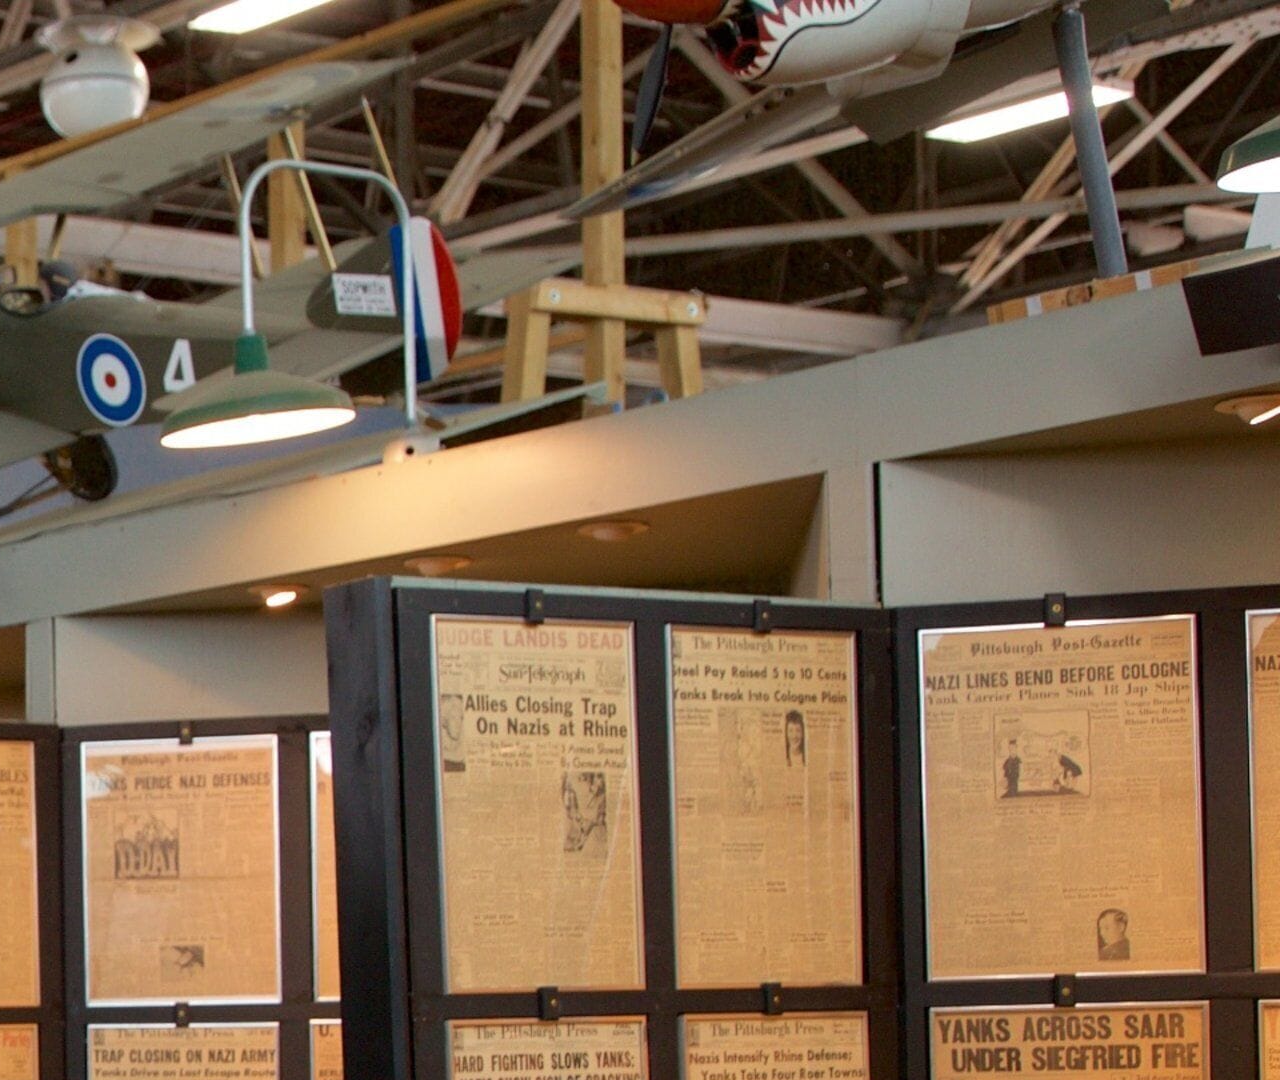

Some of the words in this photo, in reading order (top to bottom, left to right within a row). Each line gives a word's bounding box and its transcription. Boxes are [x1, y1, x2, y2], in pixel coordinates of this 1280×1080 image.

[504, 630, 567, 648] LANDIS
[577, 631, 623, 650] DEAD
[705, 665, 725, 680] Pay
[732, 666, 767, 679] Raised
[773, 667, 779, 679] 5
[784, 667, 796, 680] to
[801, 668, 812, 680] 10
[818, 668, 847, 681] Cents
[926, 673, 961, 691] NAZI
[966, 671, 1008, 689] LINES
[1015, 668, 1053, 687] BEND
[1060, 664, 1115, 685] BEFORE
[1121, 660, 1189, 681] COLOGNE
[465, 694, 507, 712] Allies
[516, 696, 572, 716] Closing
[581, 698, 617, 717] Trap
[673, 689, 706, 700] Yanks
[712, 688, 743, 701] Break
[774, 690, 817, 705] Cologne
[821, 690, 847, 704] Plain
[477, 717, 498, 734] On
[507, 717, 550, 736] Nazis
[559, 720, 574, 736] at
[583, 720, 627, 738] Rhine
[938, 1018, 1010, 1044] YANKS
[1023, 1015, 1112, 1042] ACROSS
[1124, 1012, 1184, 1039] SAAR
[95, 1049, 123, 1063] TRAP
[130, 1049, 180, 1063] CLOSING
[186, 1049, 201, 1063] ON
[208, 1049, 235, 1063] NAZI
[241, 1049, 275, 1063] ARMY
[453, 1055, 483, 1073] HARD
[491, 1053, 544, 1072] FIGHTING
[551, 1052, 589, 1070] SLOWS
[689, 1052, 719, 1065] Nazis
[724, 1049, 770, 1065] Intensify
[774, 1050, 803, 1062] Rhine
[951, 1047, 1021, 1072] UNDER
[1031, 1044, 1141, 1071] SIEGFRIED
[1151, 1043, 1199, 1069] FIRE
[741, 1068, 767, 1080] Take
[772, 1068, 796, 1080] Four
[800, 1067, 824, 1080] Roer
